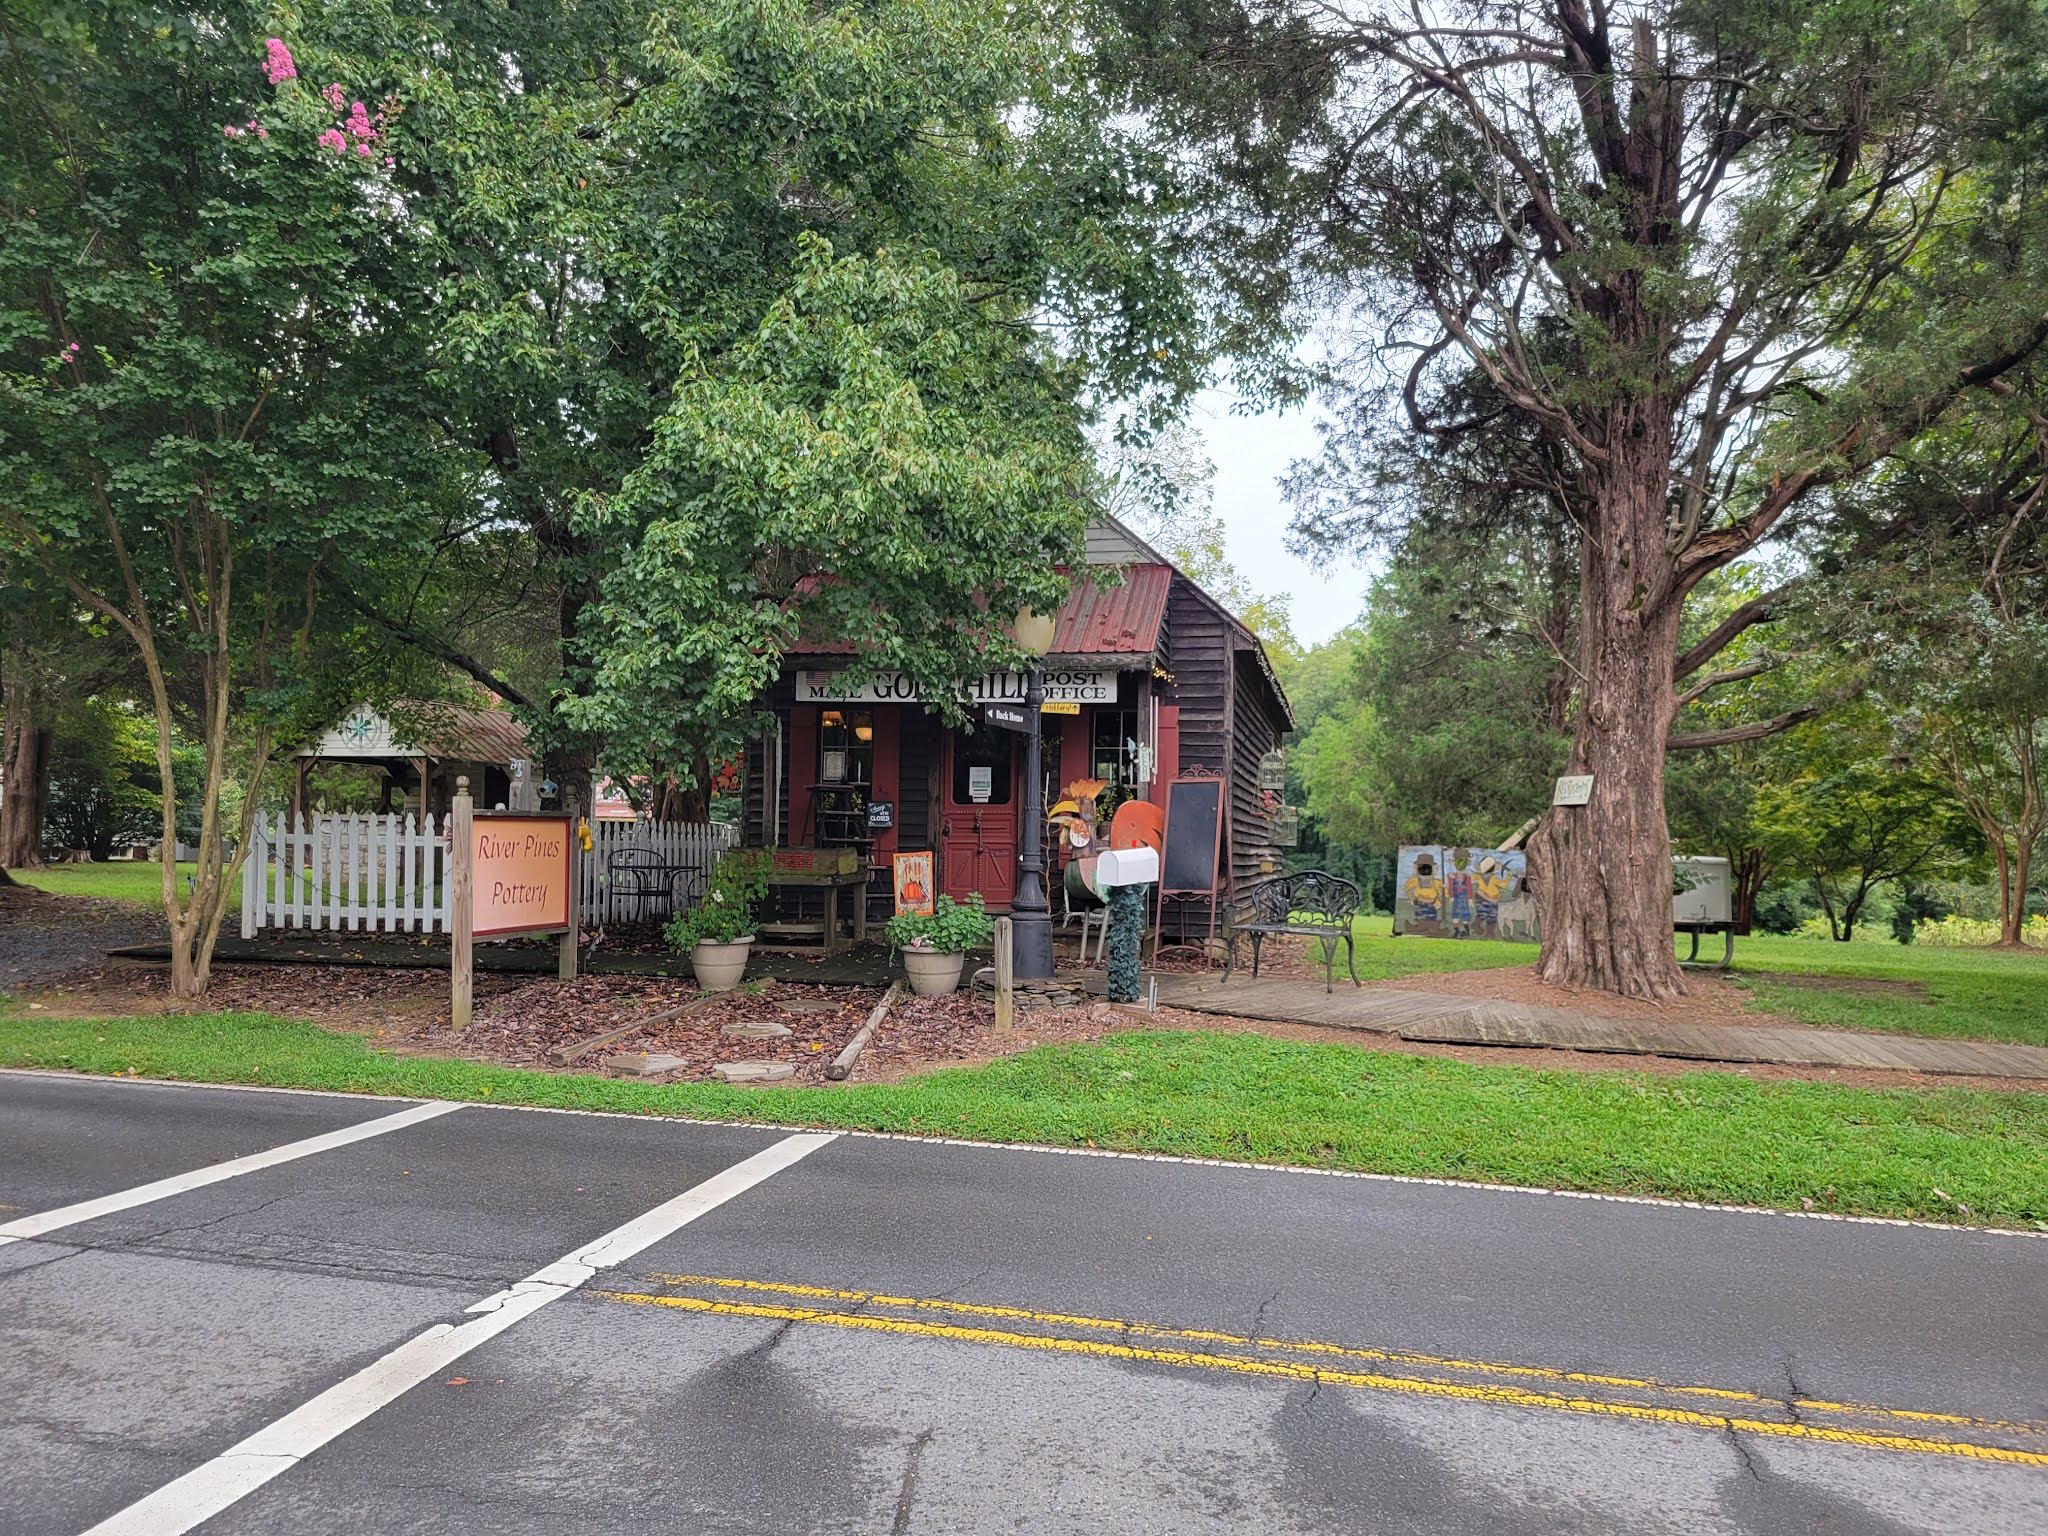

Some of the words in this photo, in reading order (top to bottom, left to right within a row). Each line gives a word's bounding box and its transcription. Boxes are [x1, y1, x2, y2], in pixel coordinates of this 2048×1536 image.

[873, 672, 936, 699] GO
[1042, 672, 1103, 686] POST
[809, 686, 863, 698] ML
[996, 709, 1009, 721] Back
[1009, 711, 1024, 723] Home
[478, 833, 521, 860] River
[523, 832, 561, 859] Pines
[491, 881, 549, 913] Pottery
